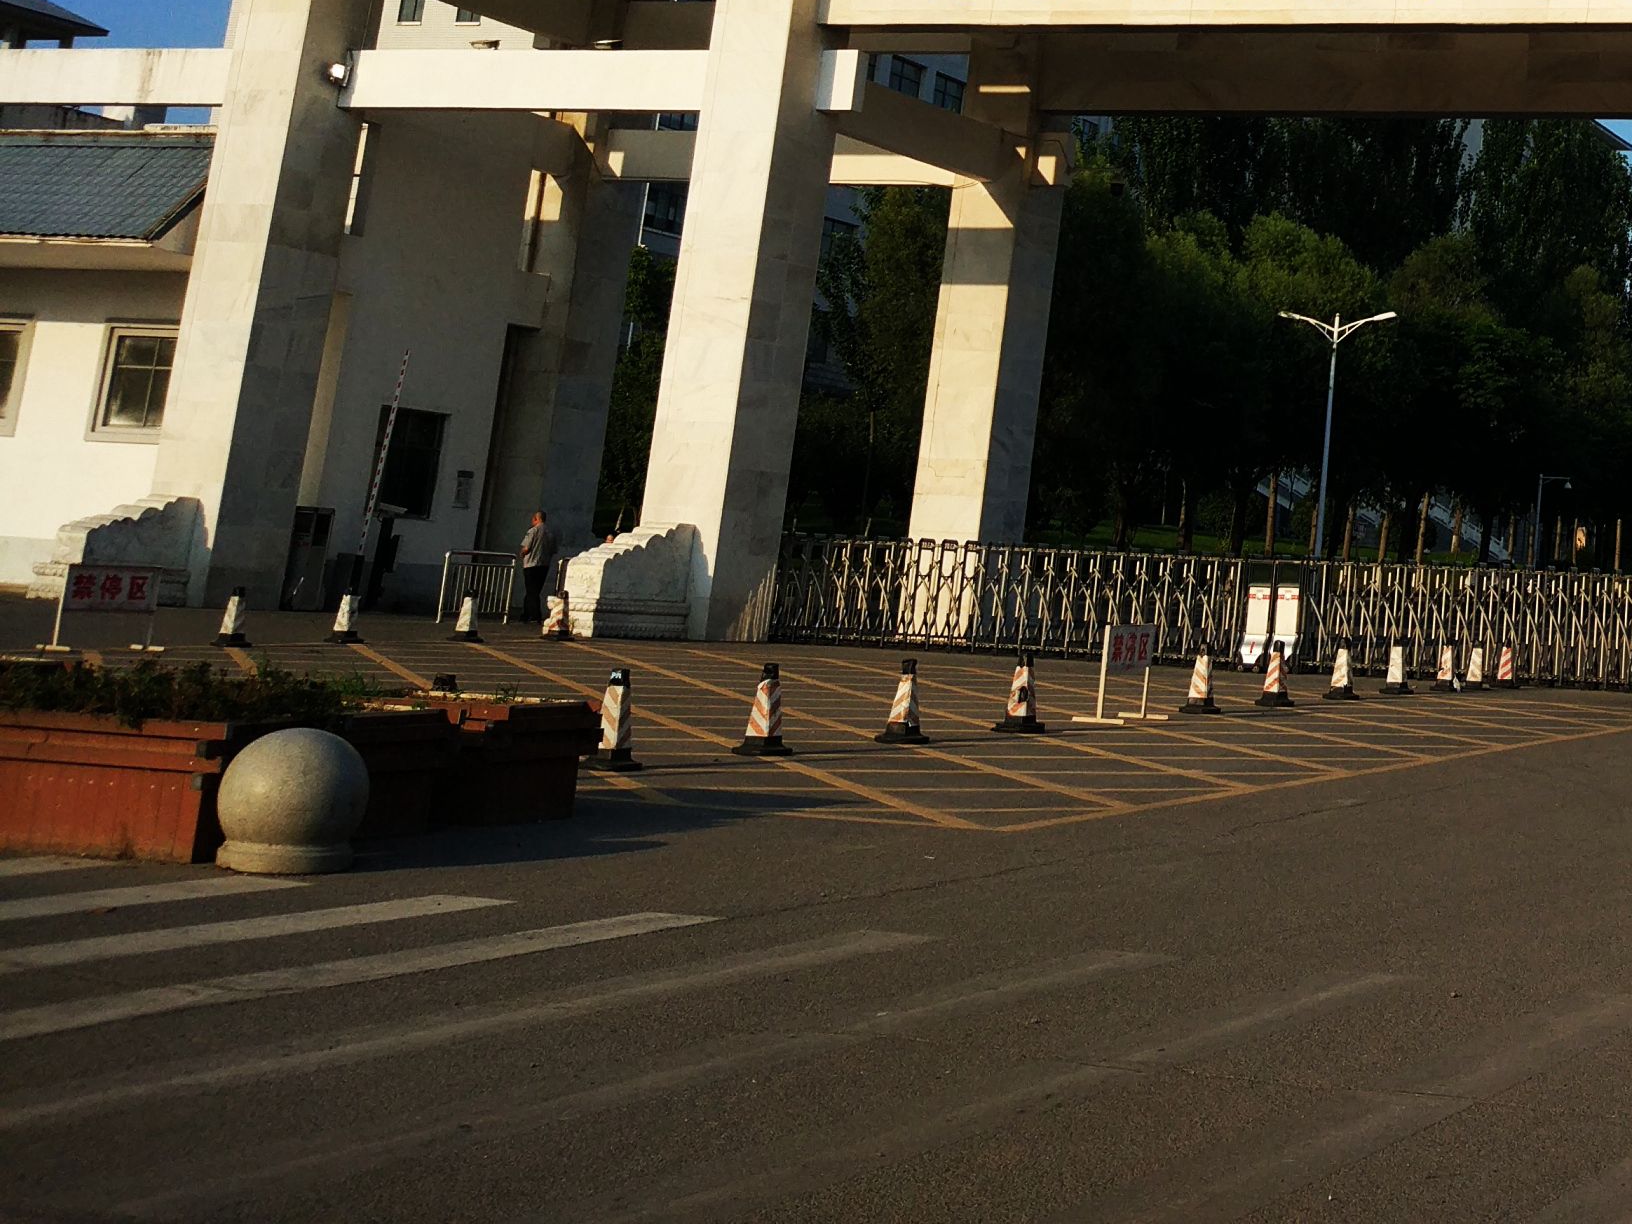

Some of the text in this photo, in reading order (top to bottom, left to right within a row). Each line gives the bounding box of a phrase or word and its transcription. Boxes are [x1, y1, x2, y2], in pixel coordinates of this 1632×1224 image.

[72, 573, 149, 601] 禁停区
[1111, 632, 1150, 663] 禁停区
